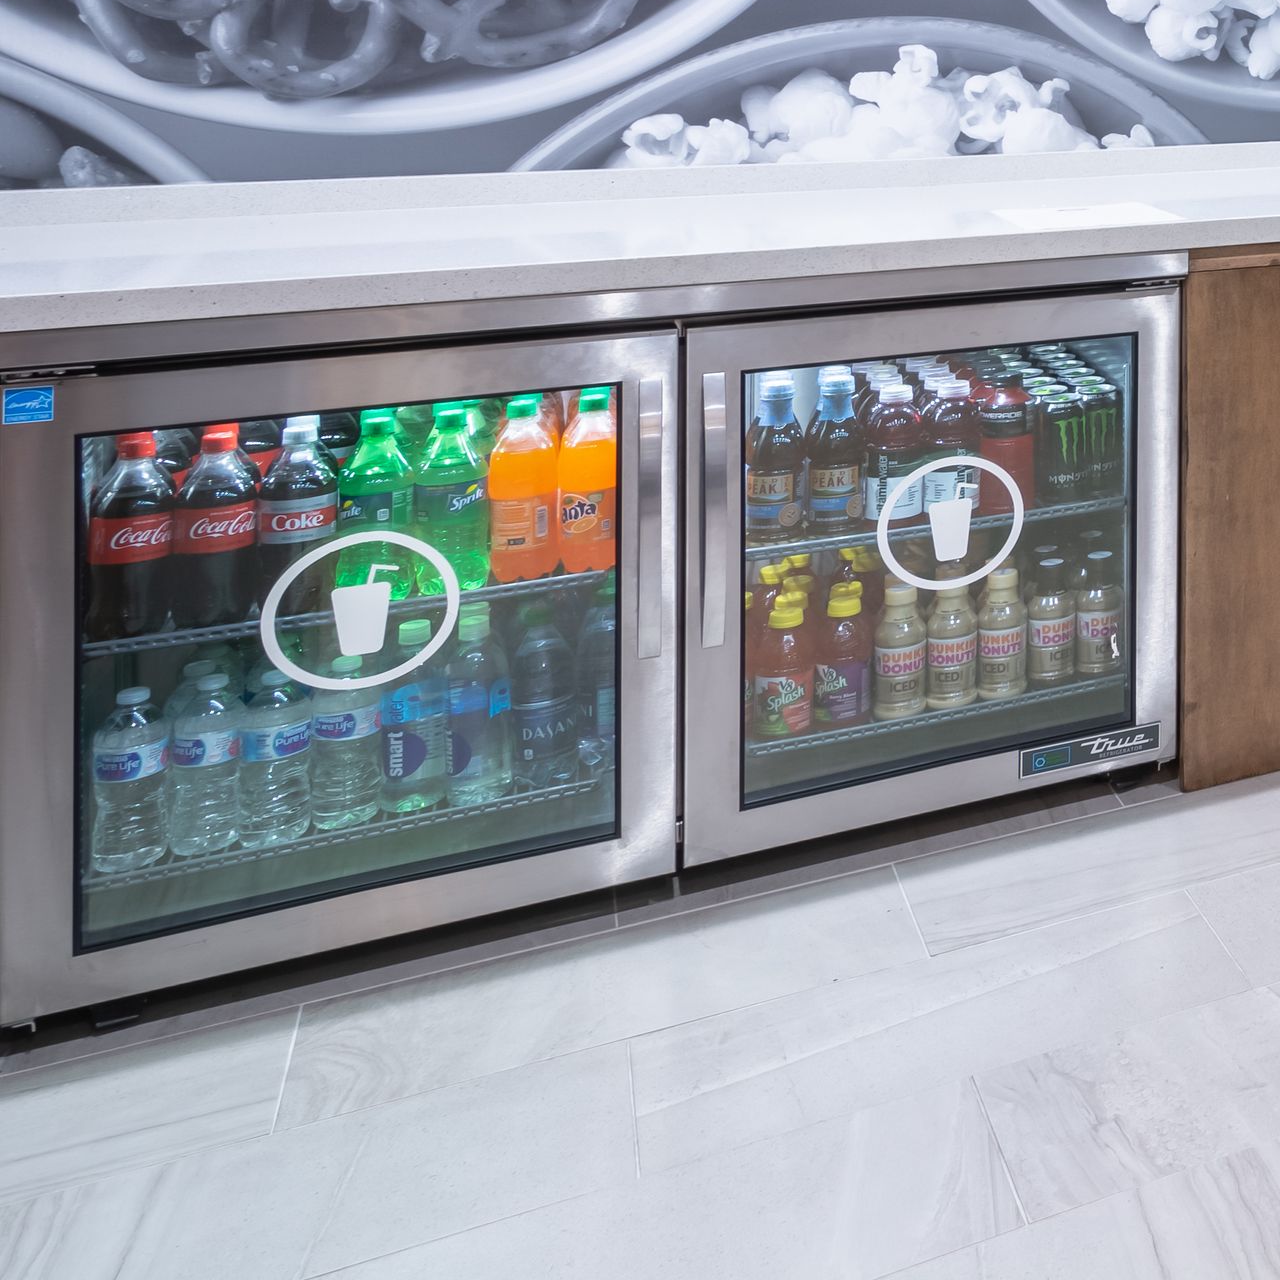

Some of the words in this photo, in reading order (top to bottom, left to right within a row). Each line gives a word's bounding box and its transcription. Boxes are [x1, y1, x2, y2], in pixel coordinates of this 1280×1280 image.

[271, 513, 324, 532] Coke
[822, 668, 836, 680] V8
[780, 680, 794, 692] V8
[815, 676, 848, 697] Splash
[768, 686, 805, 711] Splash
[389, 731, 404, 778] smart
[1099, 745, 1143, 758] REFRIGERATOR
